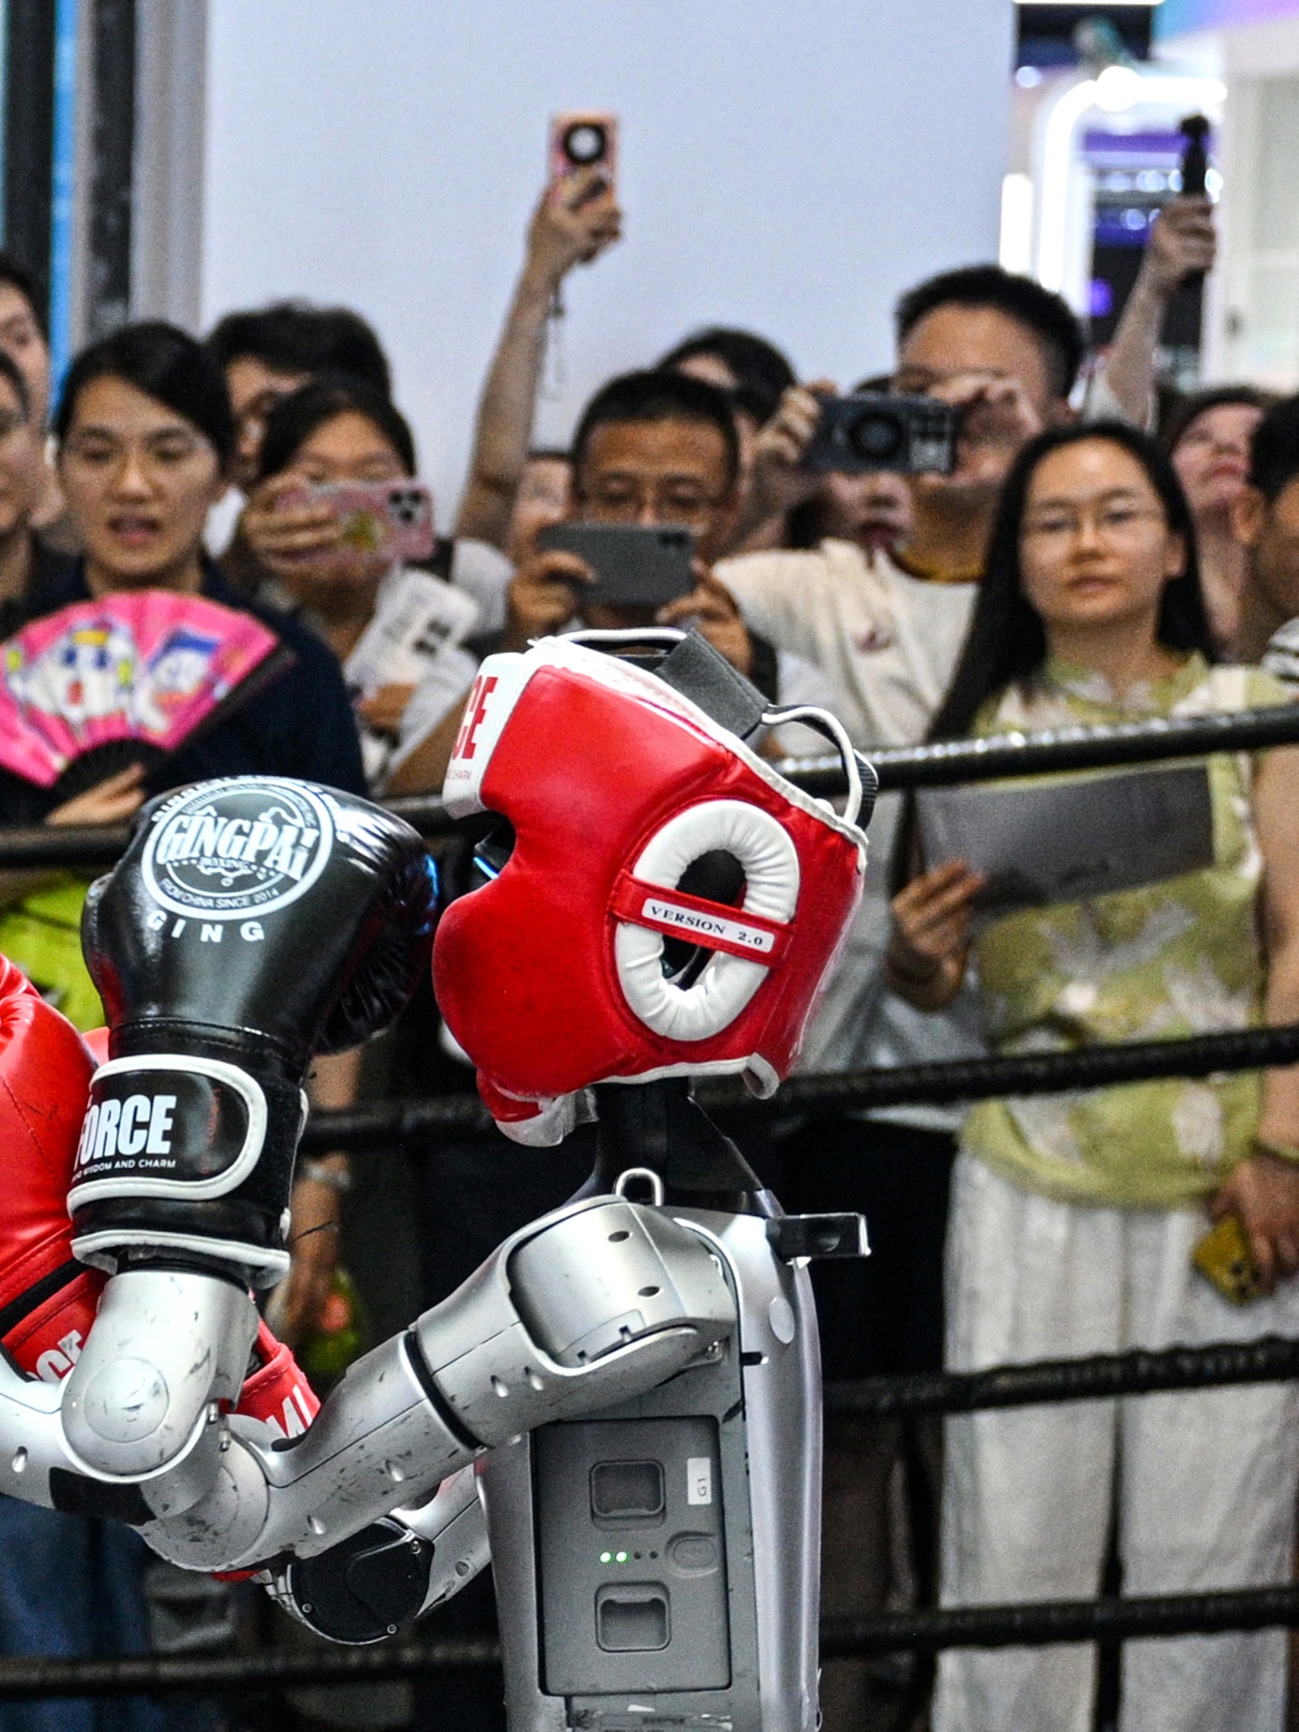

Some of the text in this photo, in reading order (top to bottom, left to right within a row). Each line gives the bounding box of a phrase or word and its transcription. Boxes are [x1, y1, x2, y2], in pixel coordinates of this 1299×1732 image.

[156, 814, 320, 882] GINGPAI
[216, 896, 252, 909] SINCE
[253, 887, 279, 904] 2014
[651, 905, 763, 947] VERSION 2.0
[83, 1159, 176, 1176] WISDOM AND CHARM
[697, 1477, 707, 1497] G1
